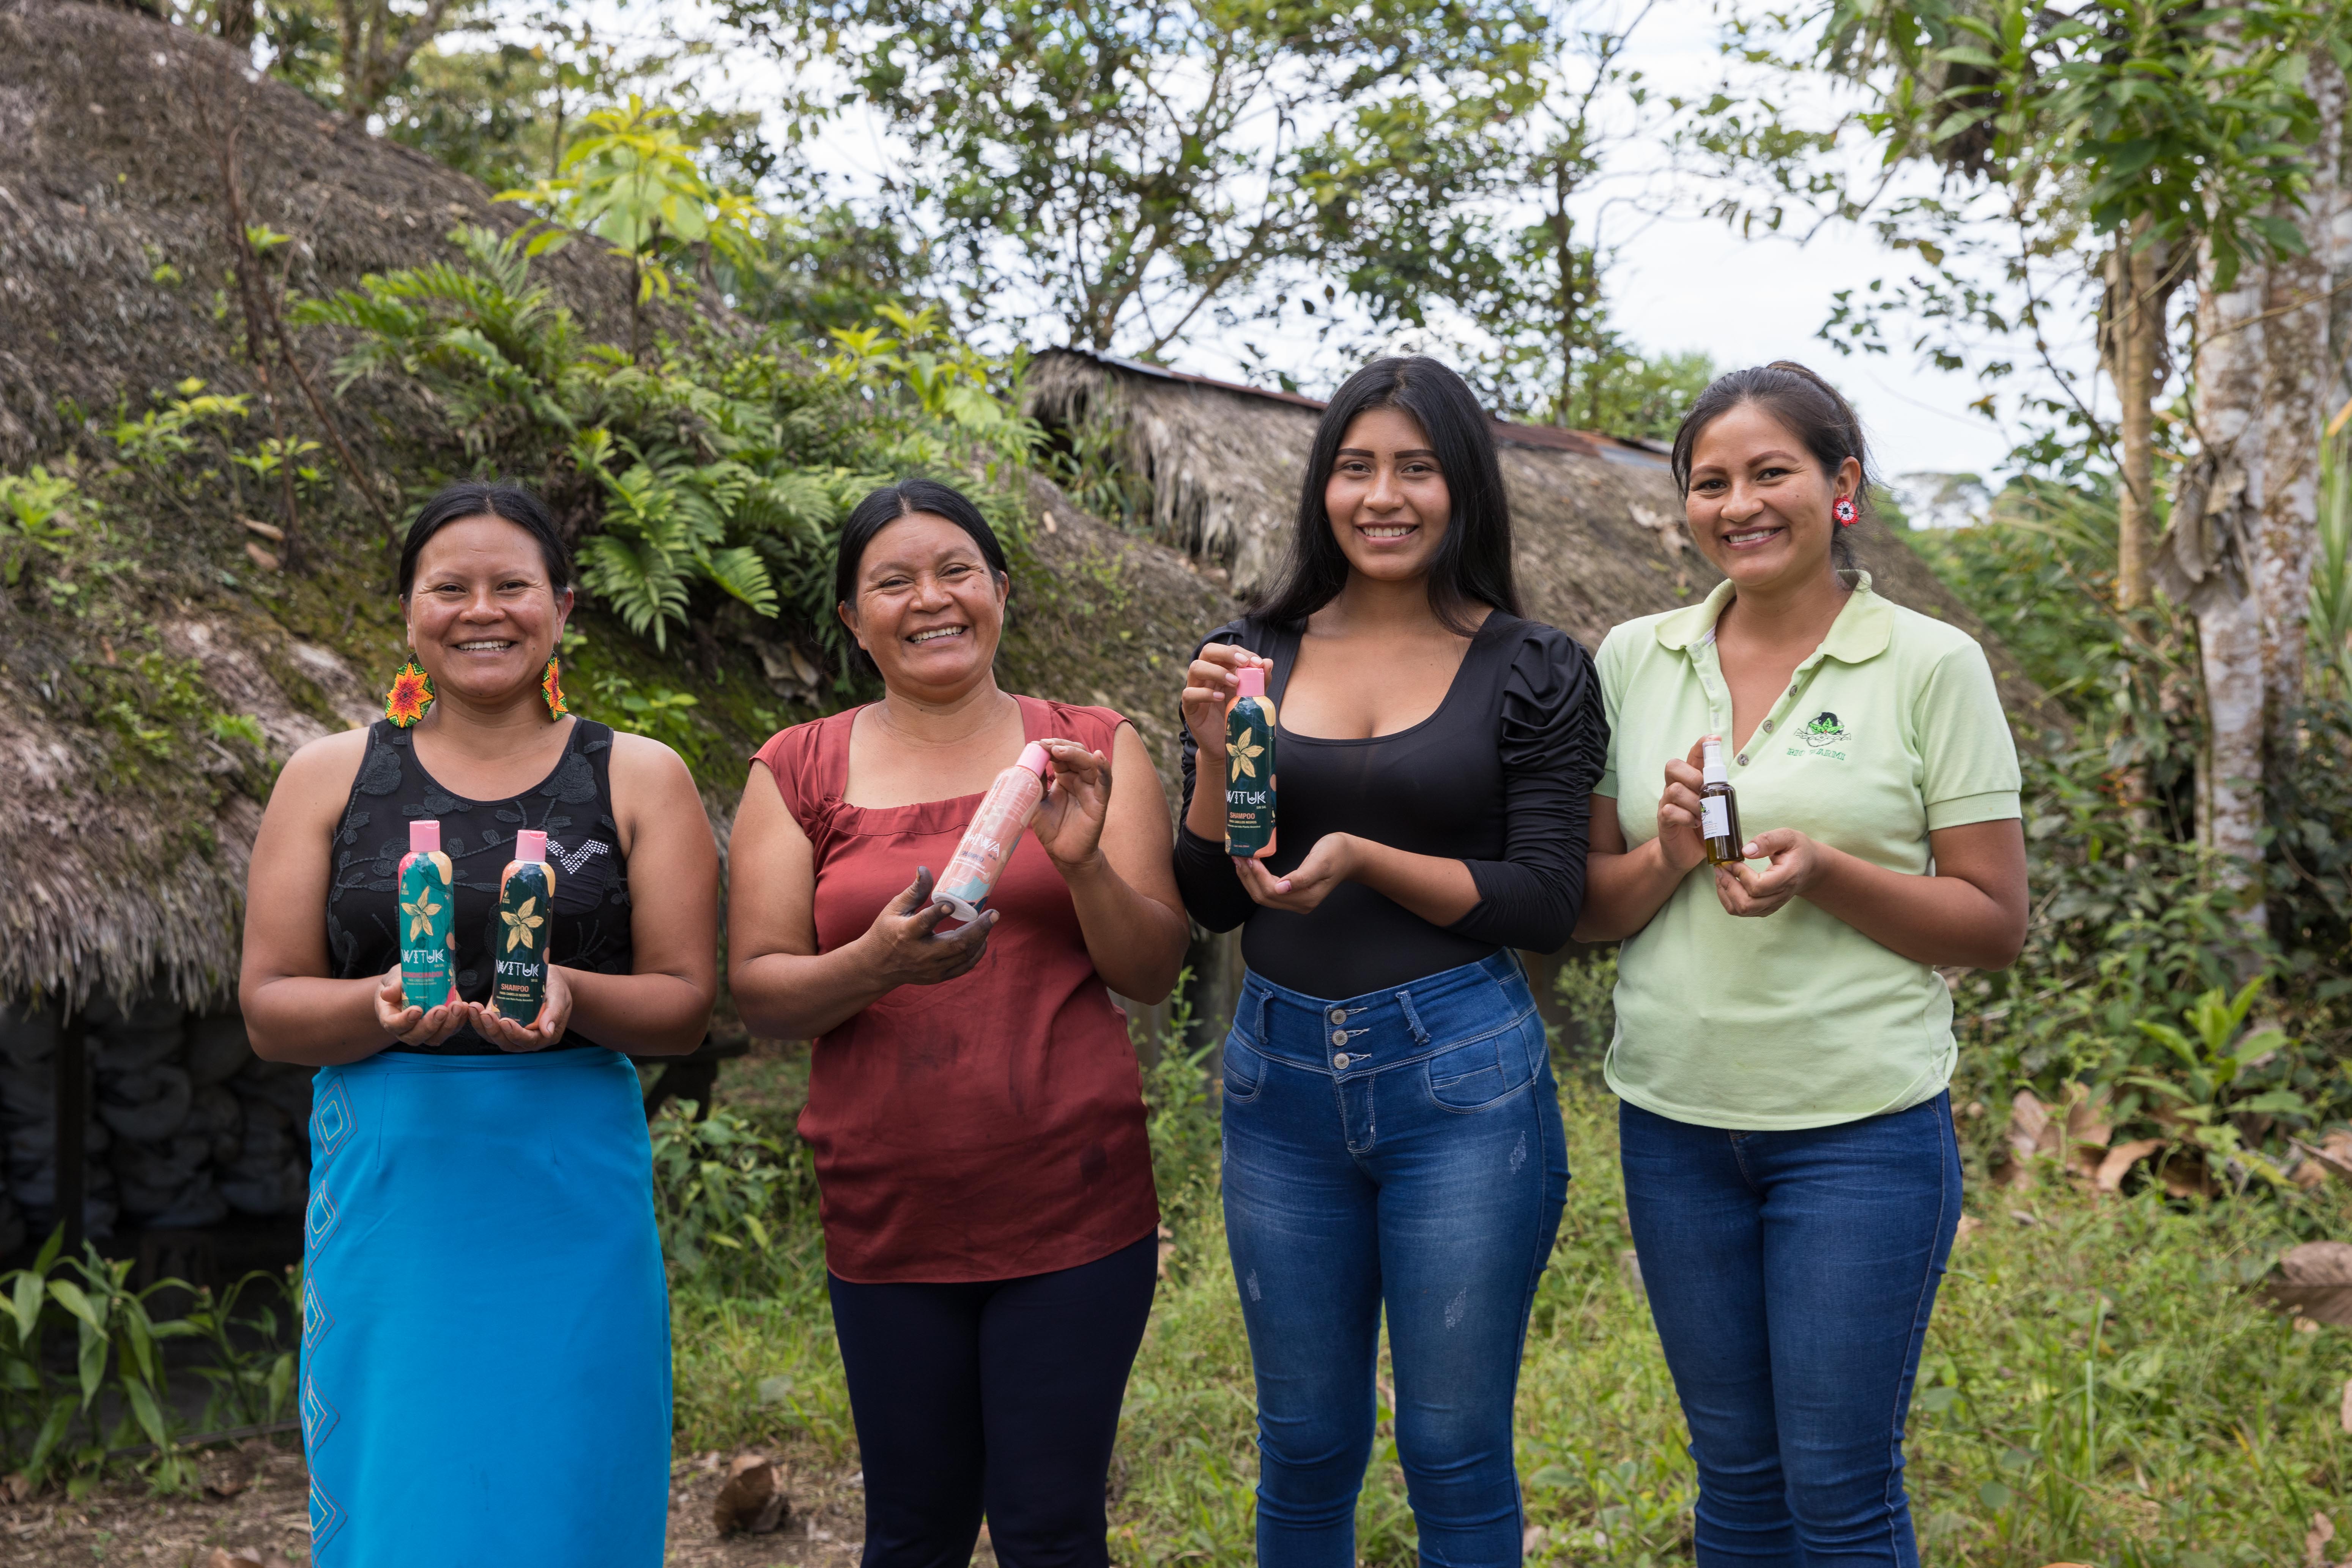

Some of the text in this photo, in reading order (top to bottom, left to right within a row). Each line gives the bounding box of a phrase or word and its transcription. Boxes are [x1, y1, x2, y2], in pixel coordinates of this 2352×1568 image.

[1809, 749, 1846, 760] WARMI
[1226, 790, 1266, 804] WITUK
[401, 949, 444, 964] WITUK
[496, 959, 540, 977] WITUK
[501, 983, 529, 992] SHAMPOO
